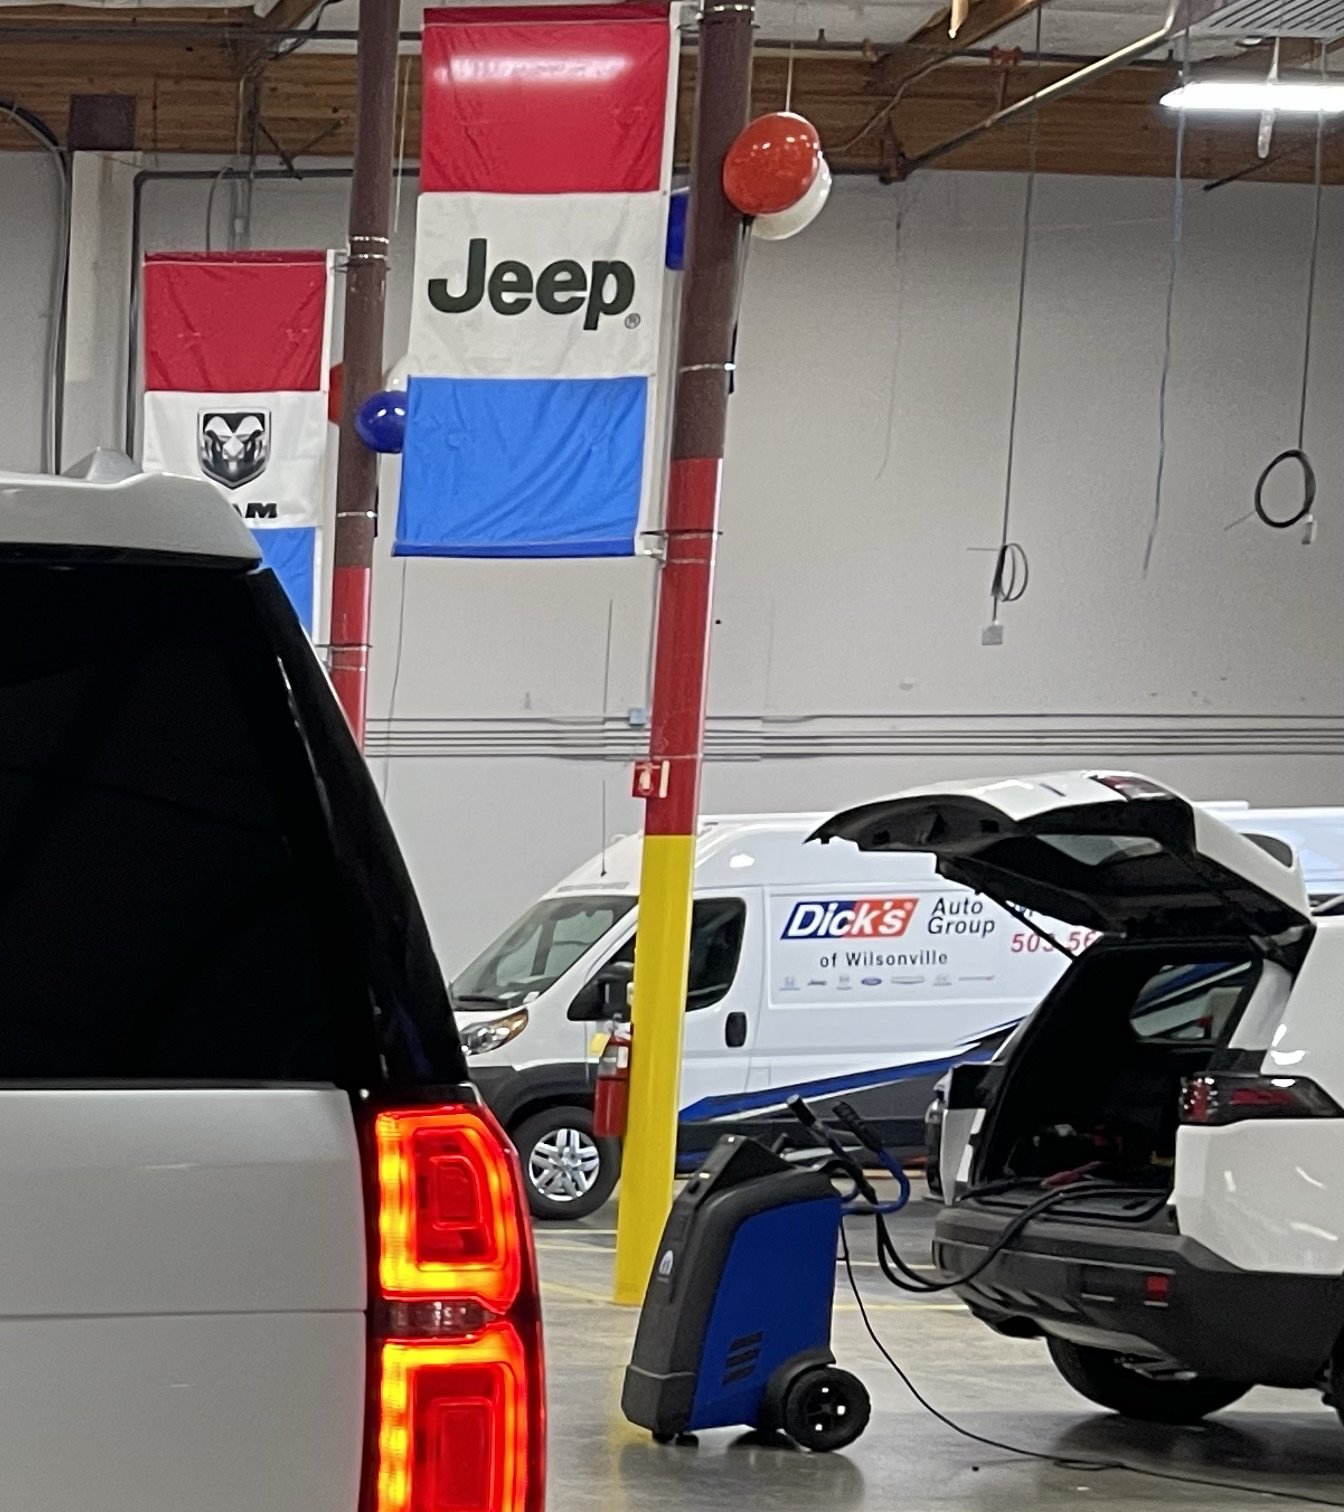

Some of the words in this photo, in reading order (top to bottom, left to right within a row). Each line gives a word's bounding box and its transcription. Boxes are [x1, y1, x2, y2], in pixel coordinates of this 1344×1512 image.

[427, 237, 636, 331] Jeep
[786, 900, 909, 938] Dick's
[931, 896, 984, 916] Auto
[927, 916, 996, 939] Group
[819, 951, 838, 968] of
[845, 949, 948, 967] Wilsonville
